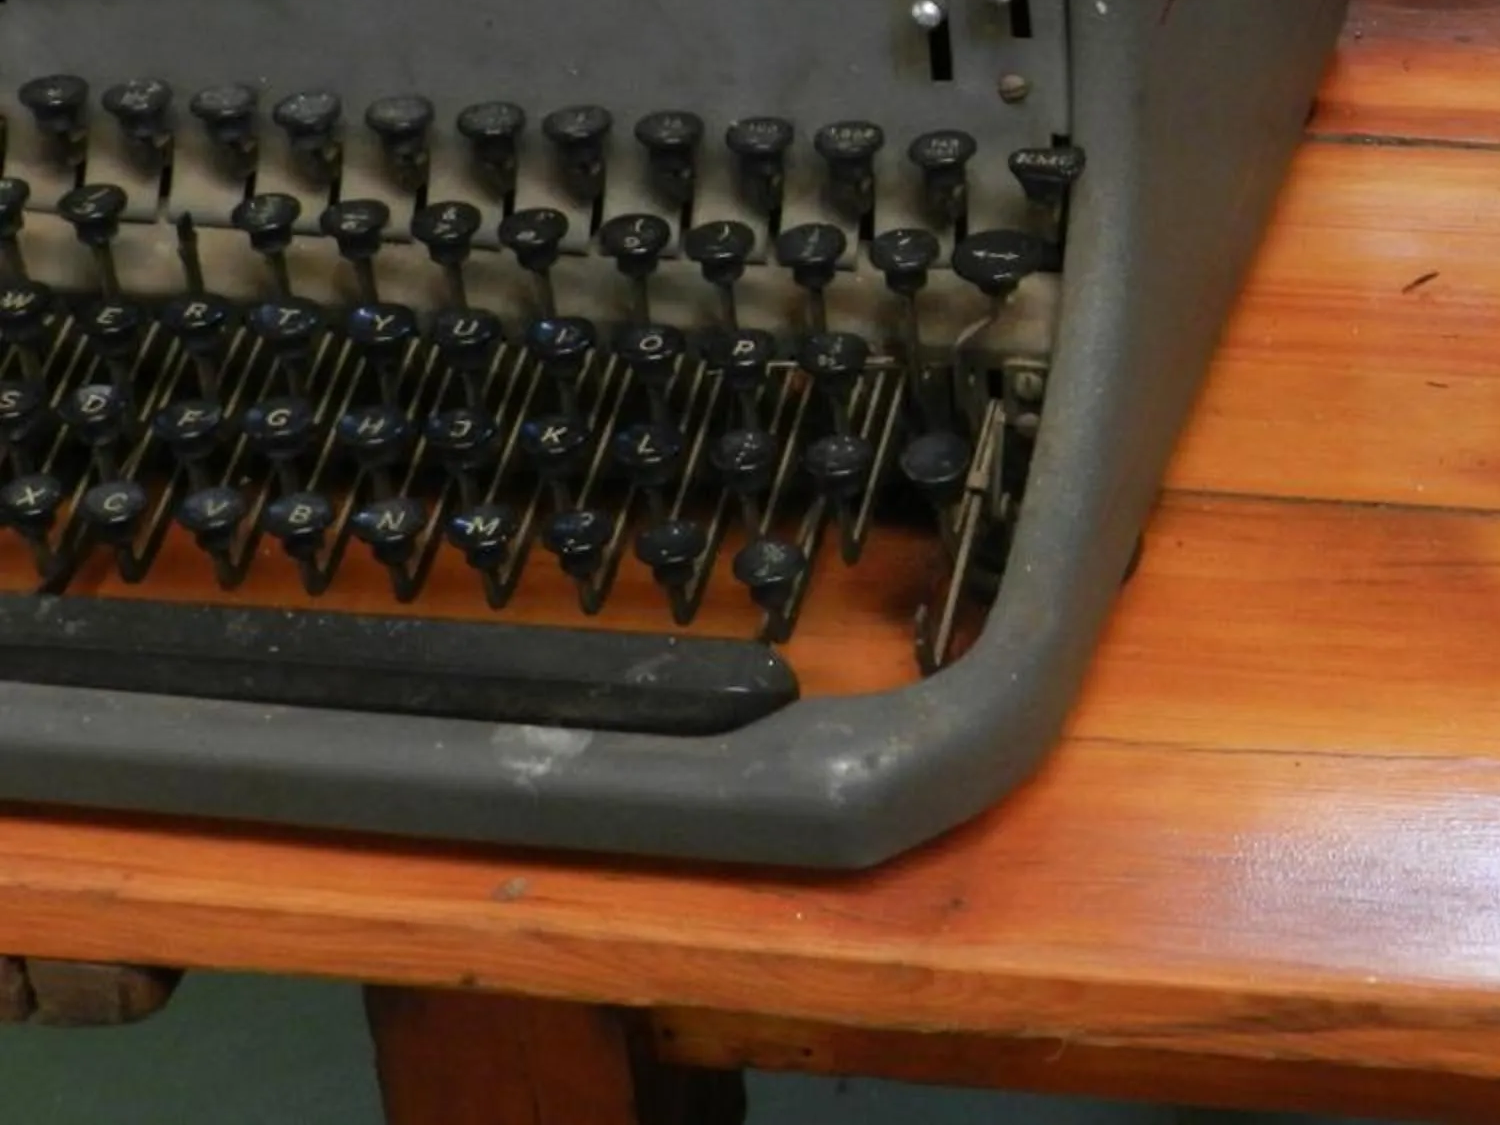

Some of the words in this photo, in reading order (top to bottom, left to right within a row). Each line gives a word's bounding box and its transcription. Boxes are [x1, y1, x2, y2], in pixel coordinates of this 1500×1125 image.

[3, 292, 34, 308] W
[96, 307, 123, 324] E
[183, 303, 209, 319] R
[280, 308, 300, 324] T
[375, 315, 393, 330] Y
[453, 319, 478, 335] U
[640, 335, 662, 350] O
[733, 341, 756, 356] P
[82, 394, 106, 412] D
[177, 409, 203, 426] F
[268, 408, 289, 425] G
[358, 418, 384, 434] H
[450, 420, 471, 438] J
[540, 427, 566, 442] K
[638, 436, 655, 453] L
[16, 486, 46, 505] X
[103, 493, 128, 510] C
[206, 499, 228, 516] V
[289, 505, 311, 523] B
[378, 511, 405, 529] N
[462, 516, 500, 535] M
